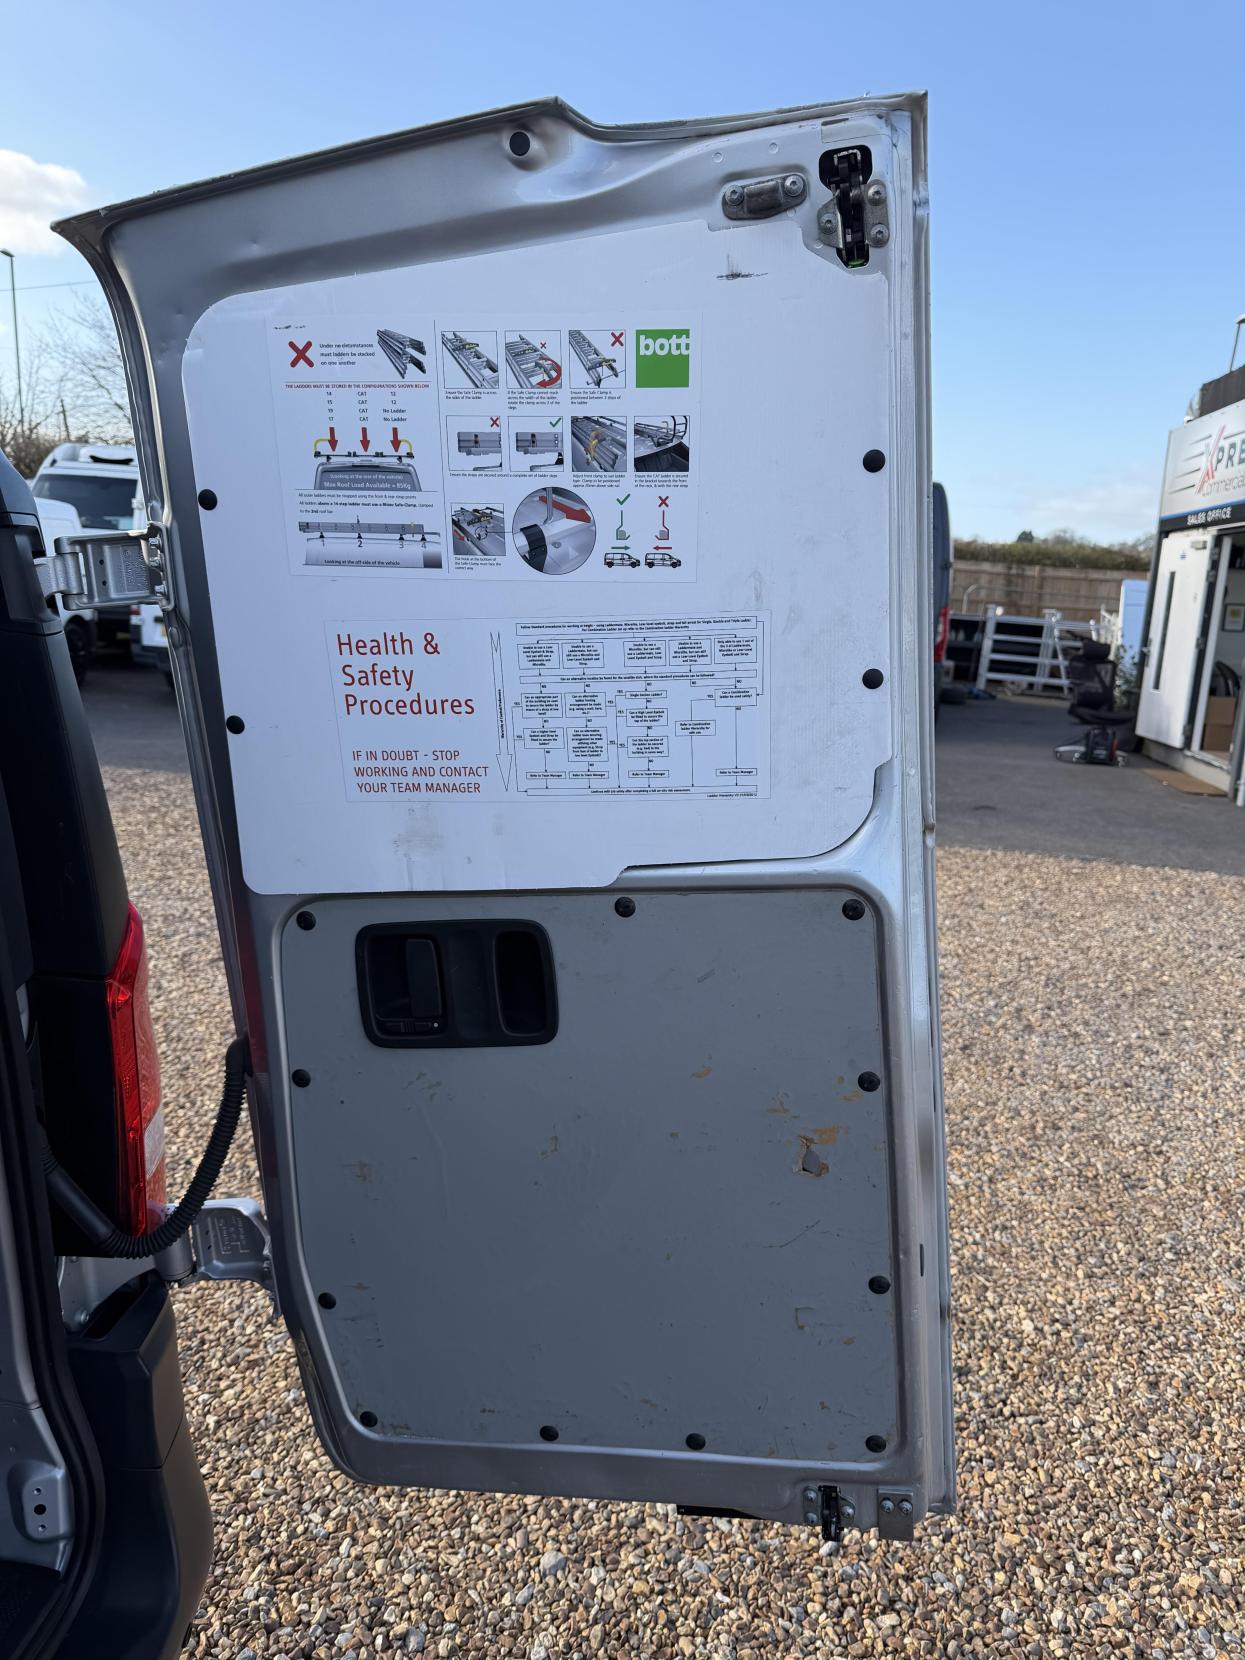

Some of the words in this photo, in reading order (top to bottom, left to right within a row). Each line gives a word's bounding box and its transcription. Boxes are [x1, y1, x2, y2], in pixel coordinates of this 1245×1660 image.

[640, 335, 690, 356] bott
[1187, 512, 1206, 526] SALES
[1206, 506, 1232, 522] OFFICE
[337, 632, 413, 656] Health
[424, 632, 440, 655] &
[342, 663, 414, 691] Safety
[345, 692, 475, 716] Procedures
[353, 750, 362, 761] IF
[366, 750, 378, 761] IN
[382, 750, 419, 761] DOUBT
[432, 750, 460, 761] STOP
[354, 766, 408, 777] WORKING
[412, 766, 436, 777] AND
[440, 766, 488, 777] CONTACT
[356, 782, 388, 793] YOUR
[390, 782, 420, 793] TEAM
[425, 782, 480, 794] MANAGER
